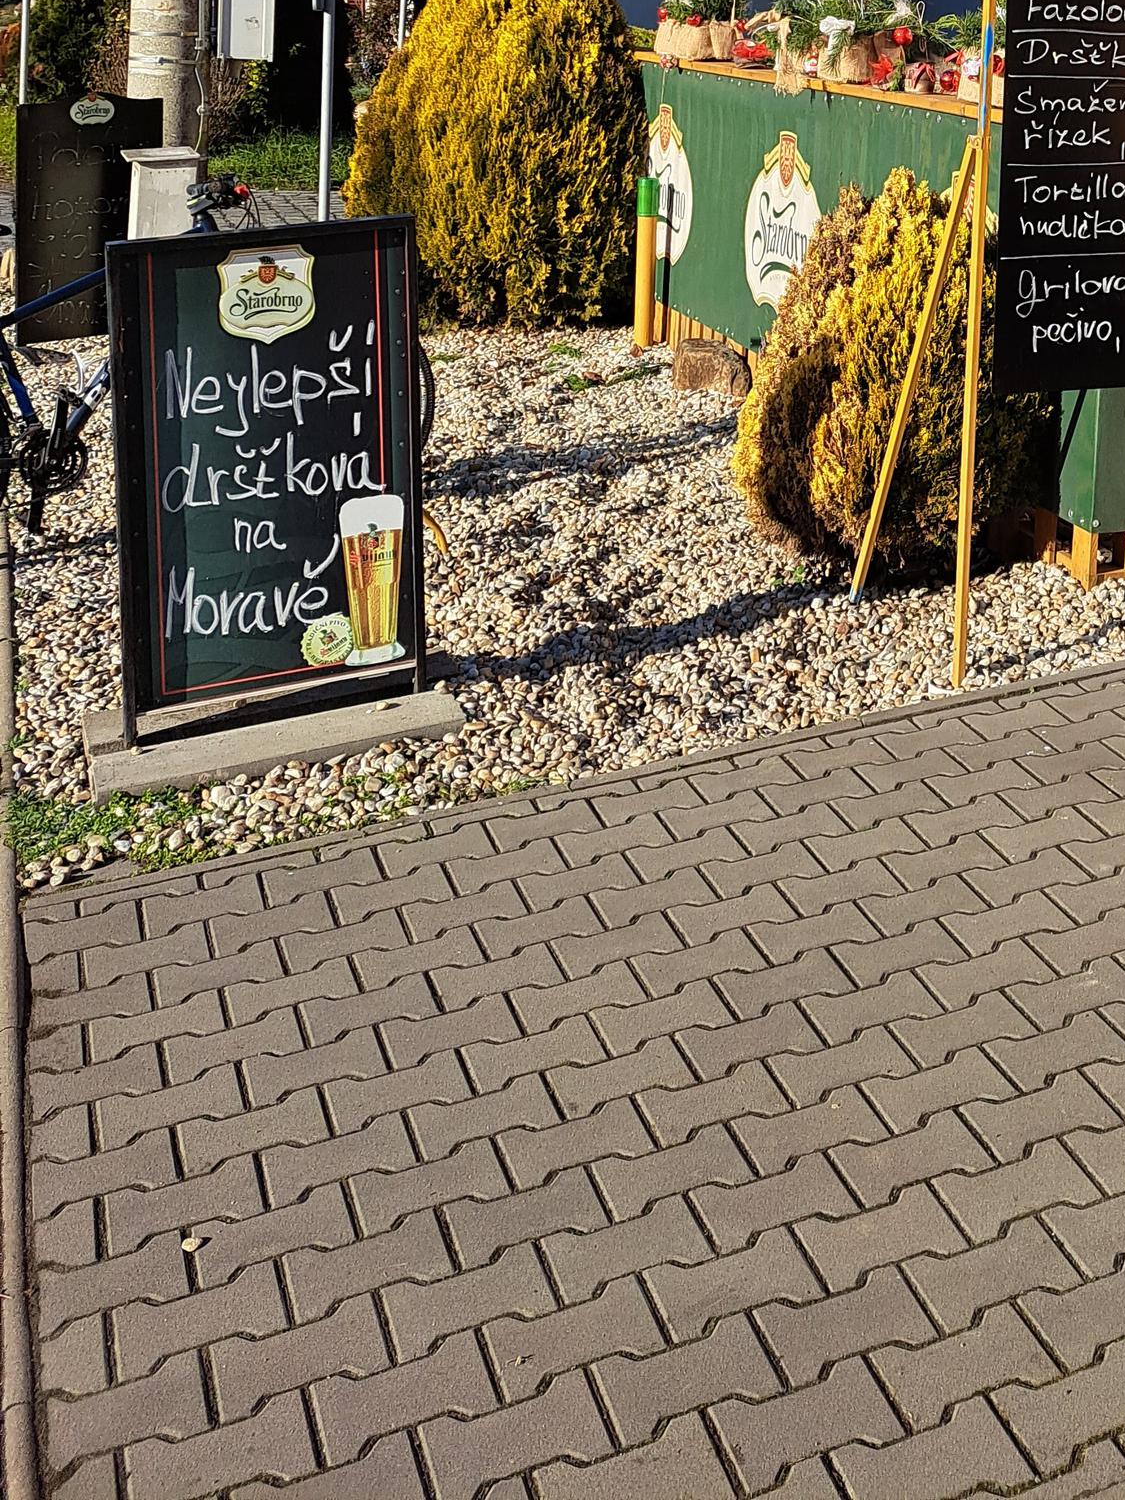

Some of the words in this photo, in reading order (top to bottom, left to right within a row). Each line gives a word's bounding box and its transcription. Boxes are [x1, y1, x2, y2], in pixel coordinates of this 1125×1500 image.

[74, 104, 111, 120] Starobrno
[752, 191, 808, 266] Starobrn
[229, 287, 303, 318] Starobrno
[234, 517, 287, 553] na
[165, 533, 340, 638] Moravě
